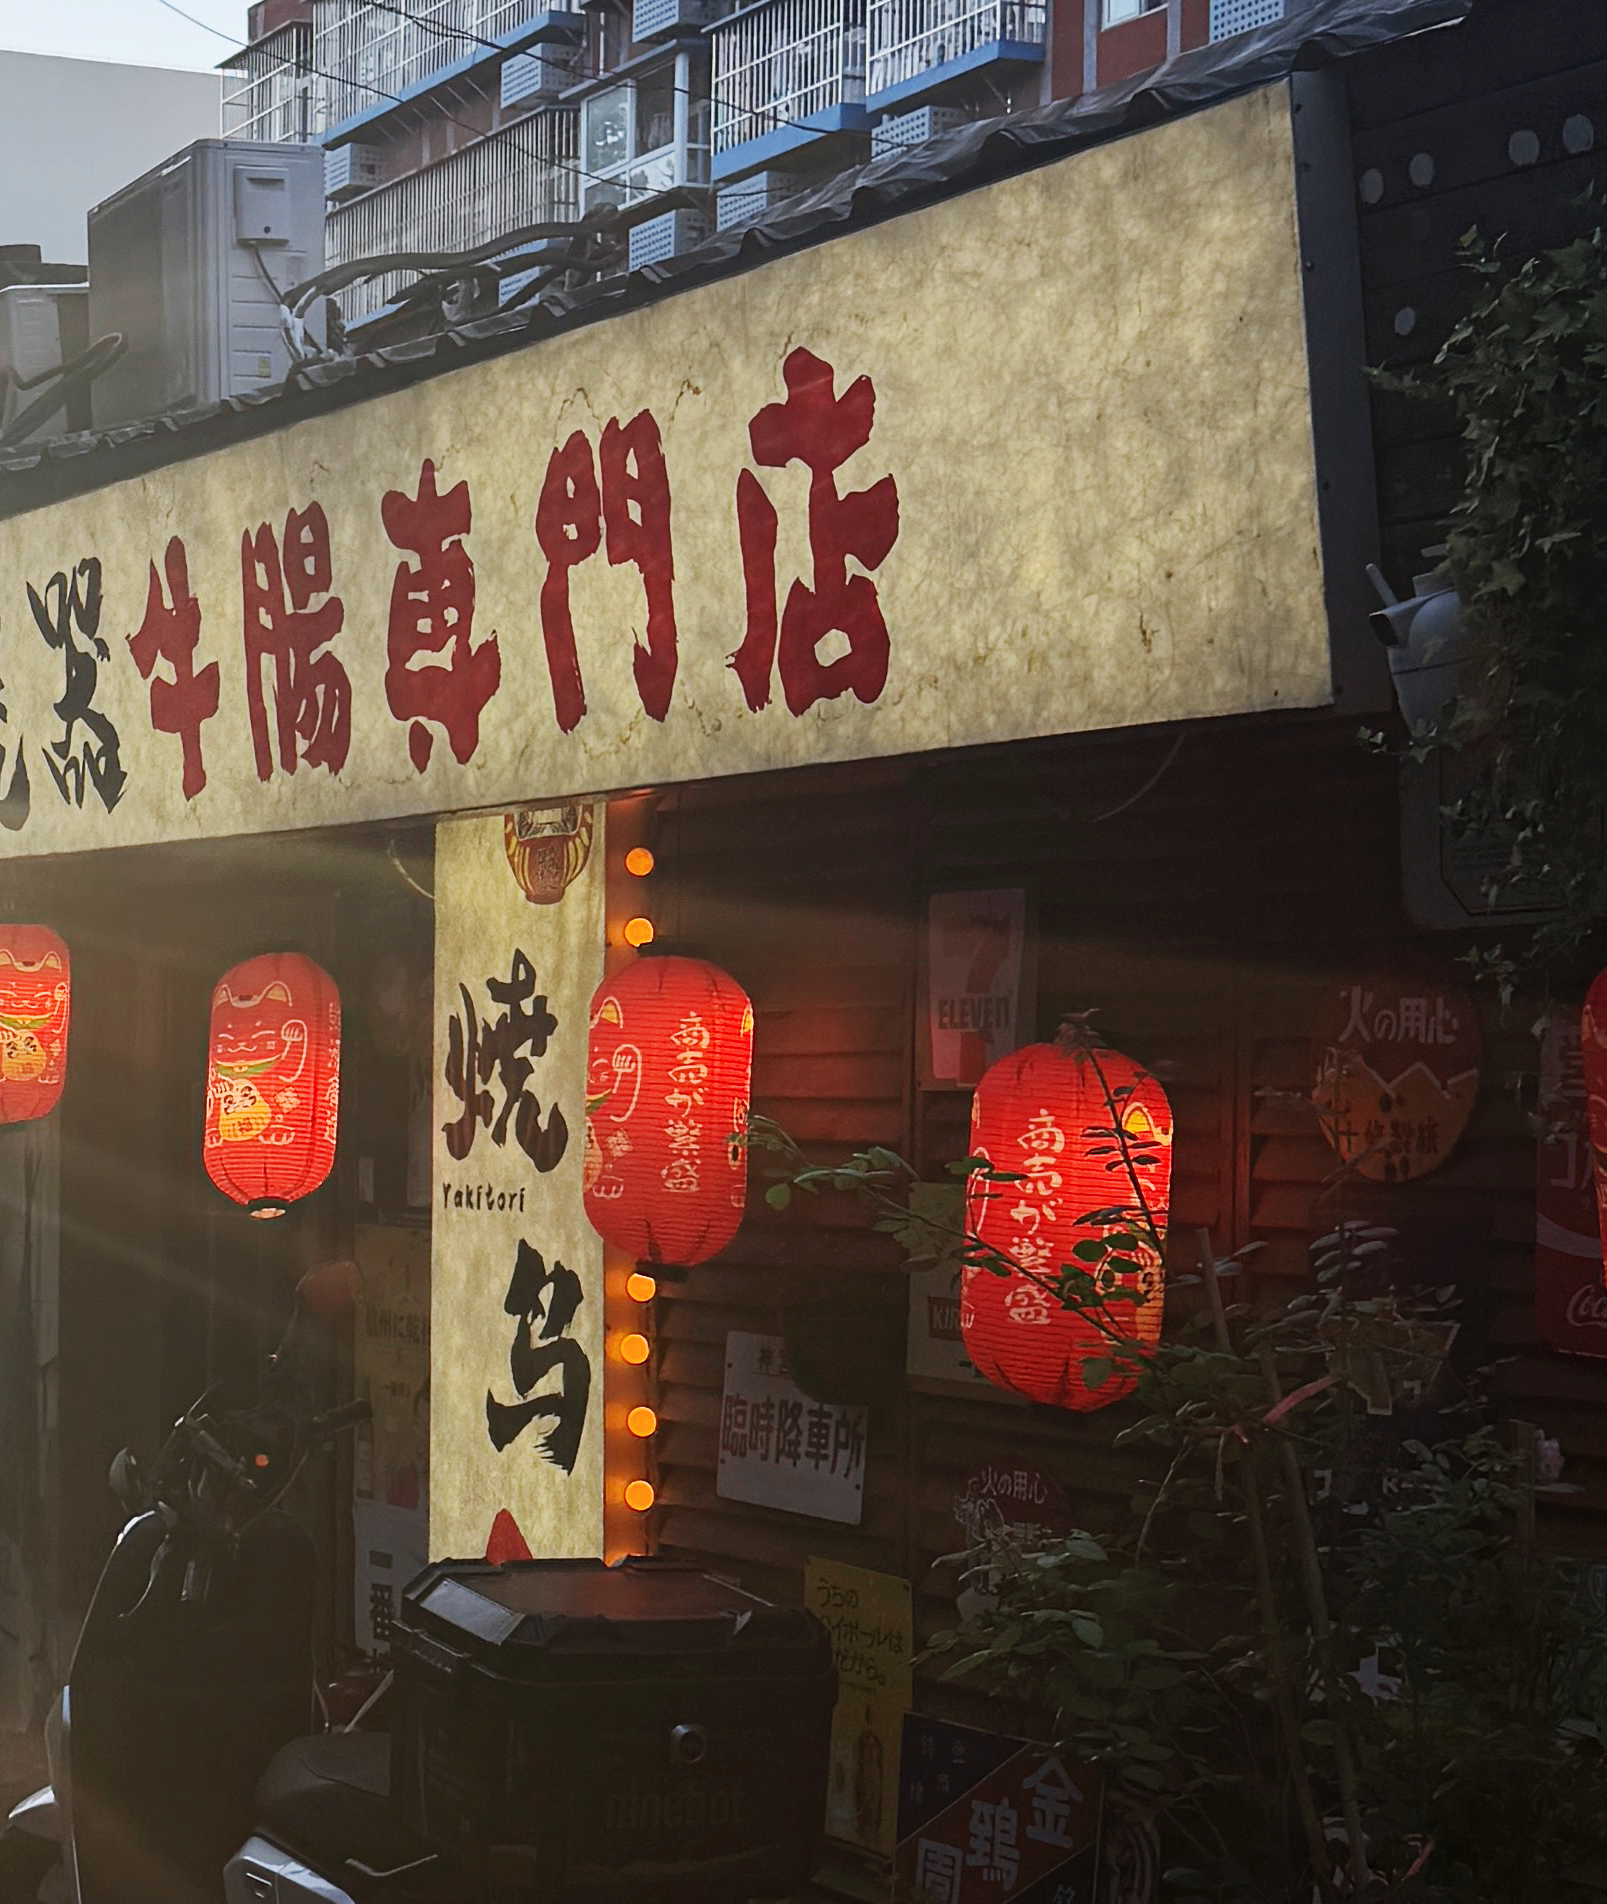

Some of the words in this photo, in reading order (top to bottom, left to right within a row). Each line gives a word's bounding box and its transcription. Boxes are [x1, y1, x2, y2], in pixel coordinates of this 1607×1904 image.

[1338, 985, 1459, 1045] 火の用心
[441, 1182, 526, 1213] Yakitori
[722, 1393, 865, 1479] 臨時降車所
[980, 1464, 1049, 1505] 火の用心
[816, 1576, 860, 1609] うちの
